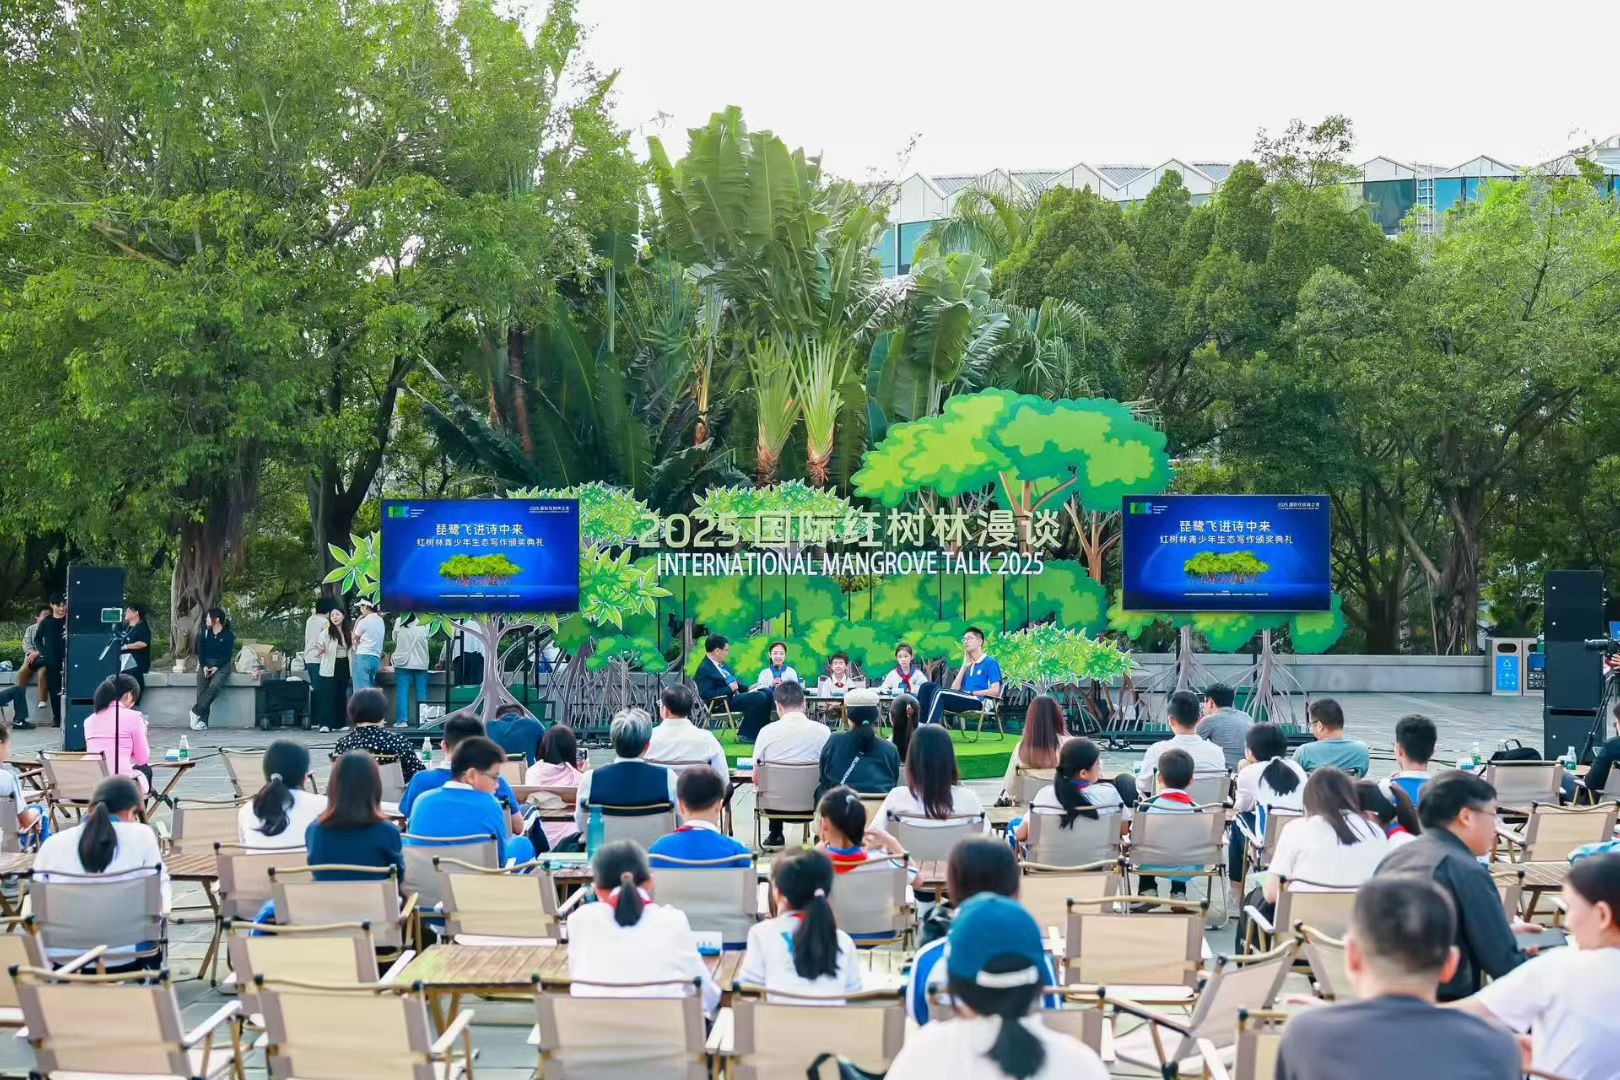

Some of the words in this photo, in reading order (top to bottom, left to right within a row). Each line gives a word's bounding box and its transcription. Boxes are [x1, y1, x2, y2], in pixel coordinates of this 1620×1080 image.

[435, 523, 524, 536] 琵鹭飞进诗中来
[638, 513, 741, 549] 2025
[754, 507, 1063, 549] 国际红树林漫谈
[1179, 520, 1271, 532] 琵鹭飞进诗中来
[416, 538, 545, 547] 红树林青少年生态写作颁奖典礼
[1159, 535, 1294, 545] 红树林青少年生态写作颁奖典礼
[657, 552, 818, 577] INTERNATIONAL
[821, 551, 938, 576] MANGROVE
[943, 551, 992, 576] TALK
[996, 551, 1044, 576] 2025
